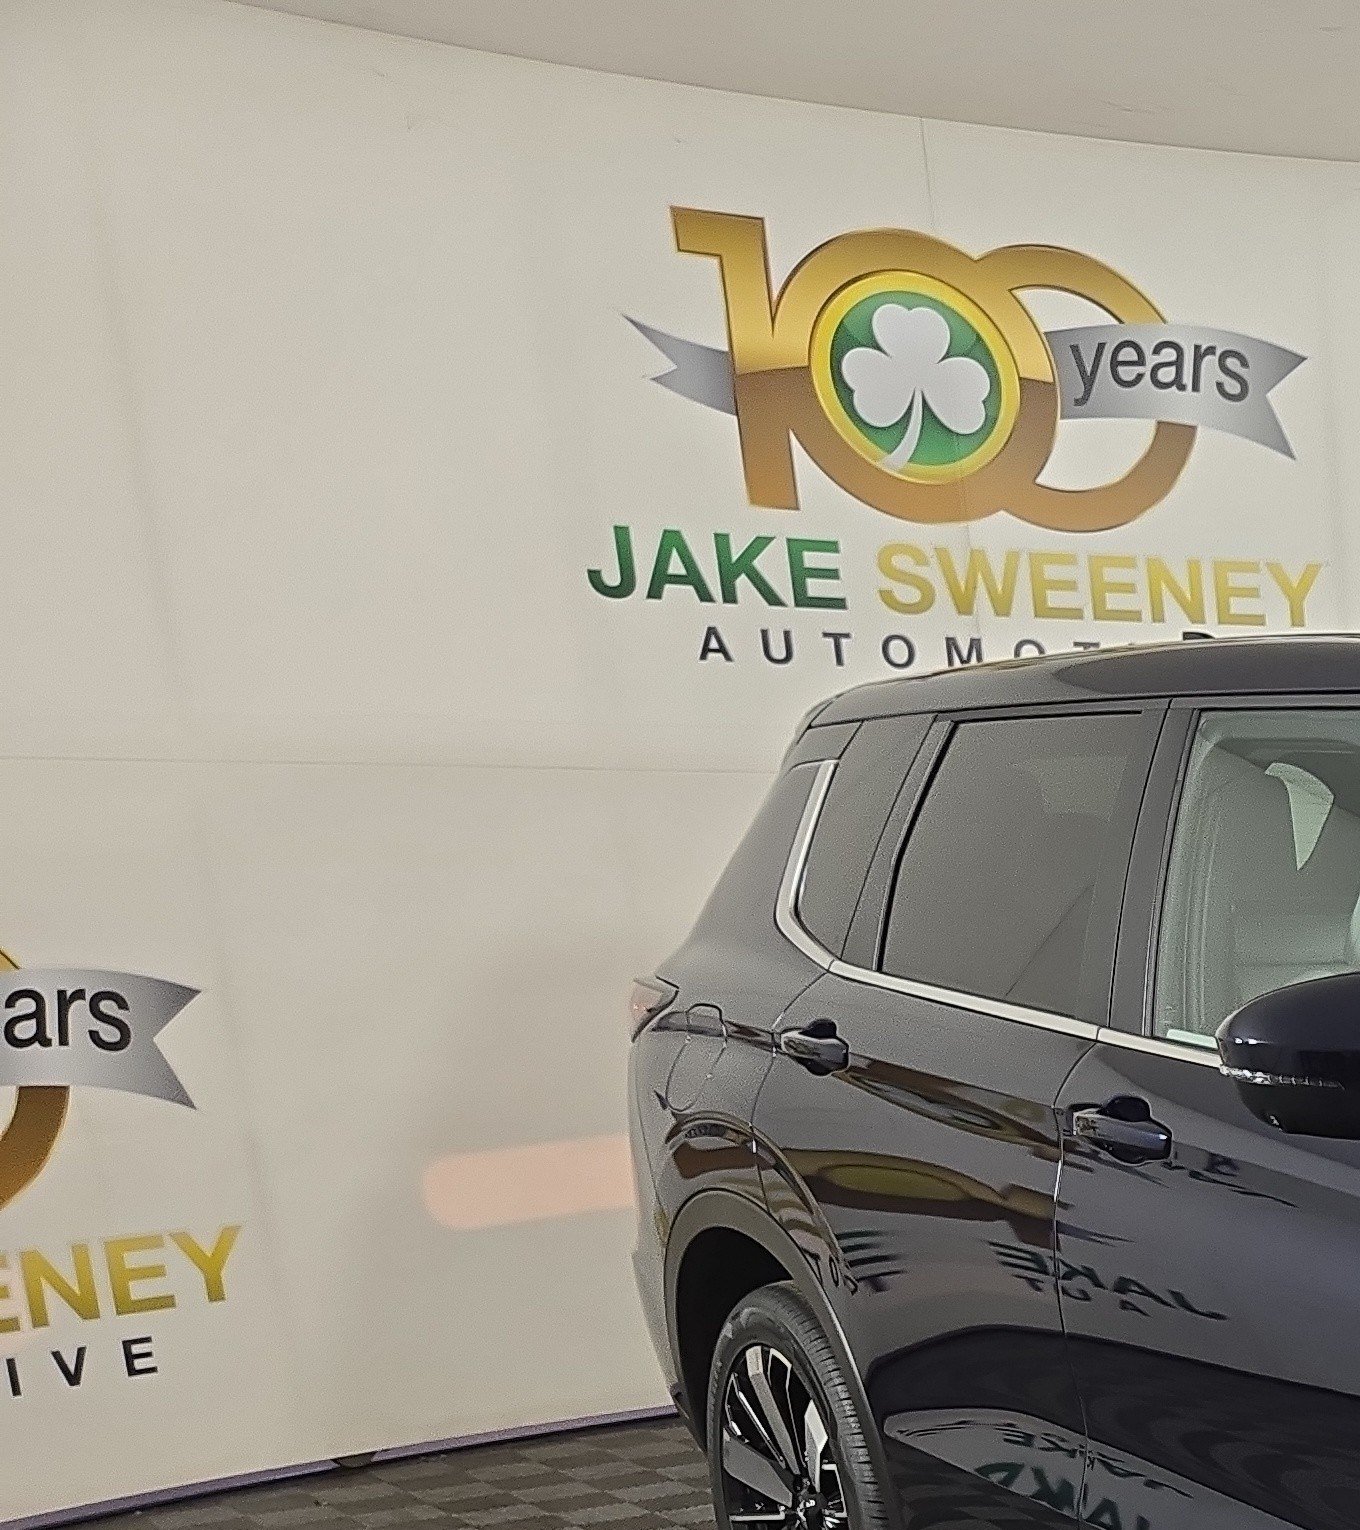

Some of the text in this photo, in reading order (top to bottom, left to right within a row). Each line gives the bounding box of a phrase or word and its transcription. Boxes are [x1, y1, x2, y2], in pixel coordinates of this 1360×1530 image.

[669, 205, 1199, 533] 100
[1069, 338, 1251, 408] years
[587, 525, 1324, 627] JAKE SWEENEY
[699, 626, 1100, 669] AUTOMO
